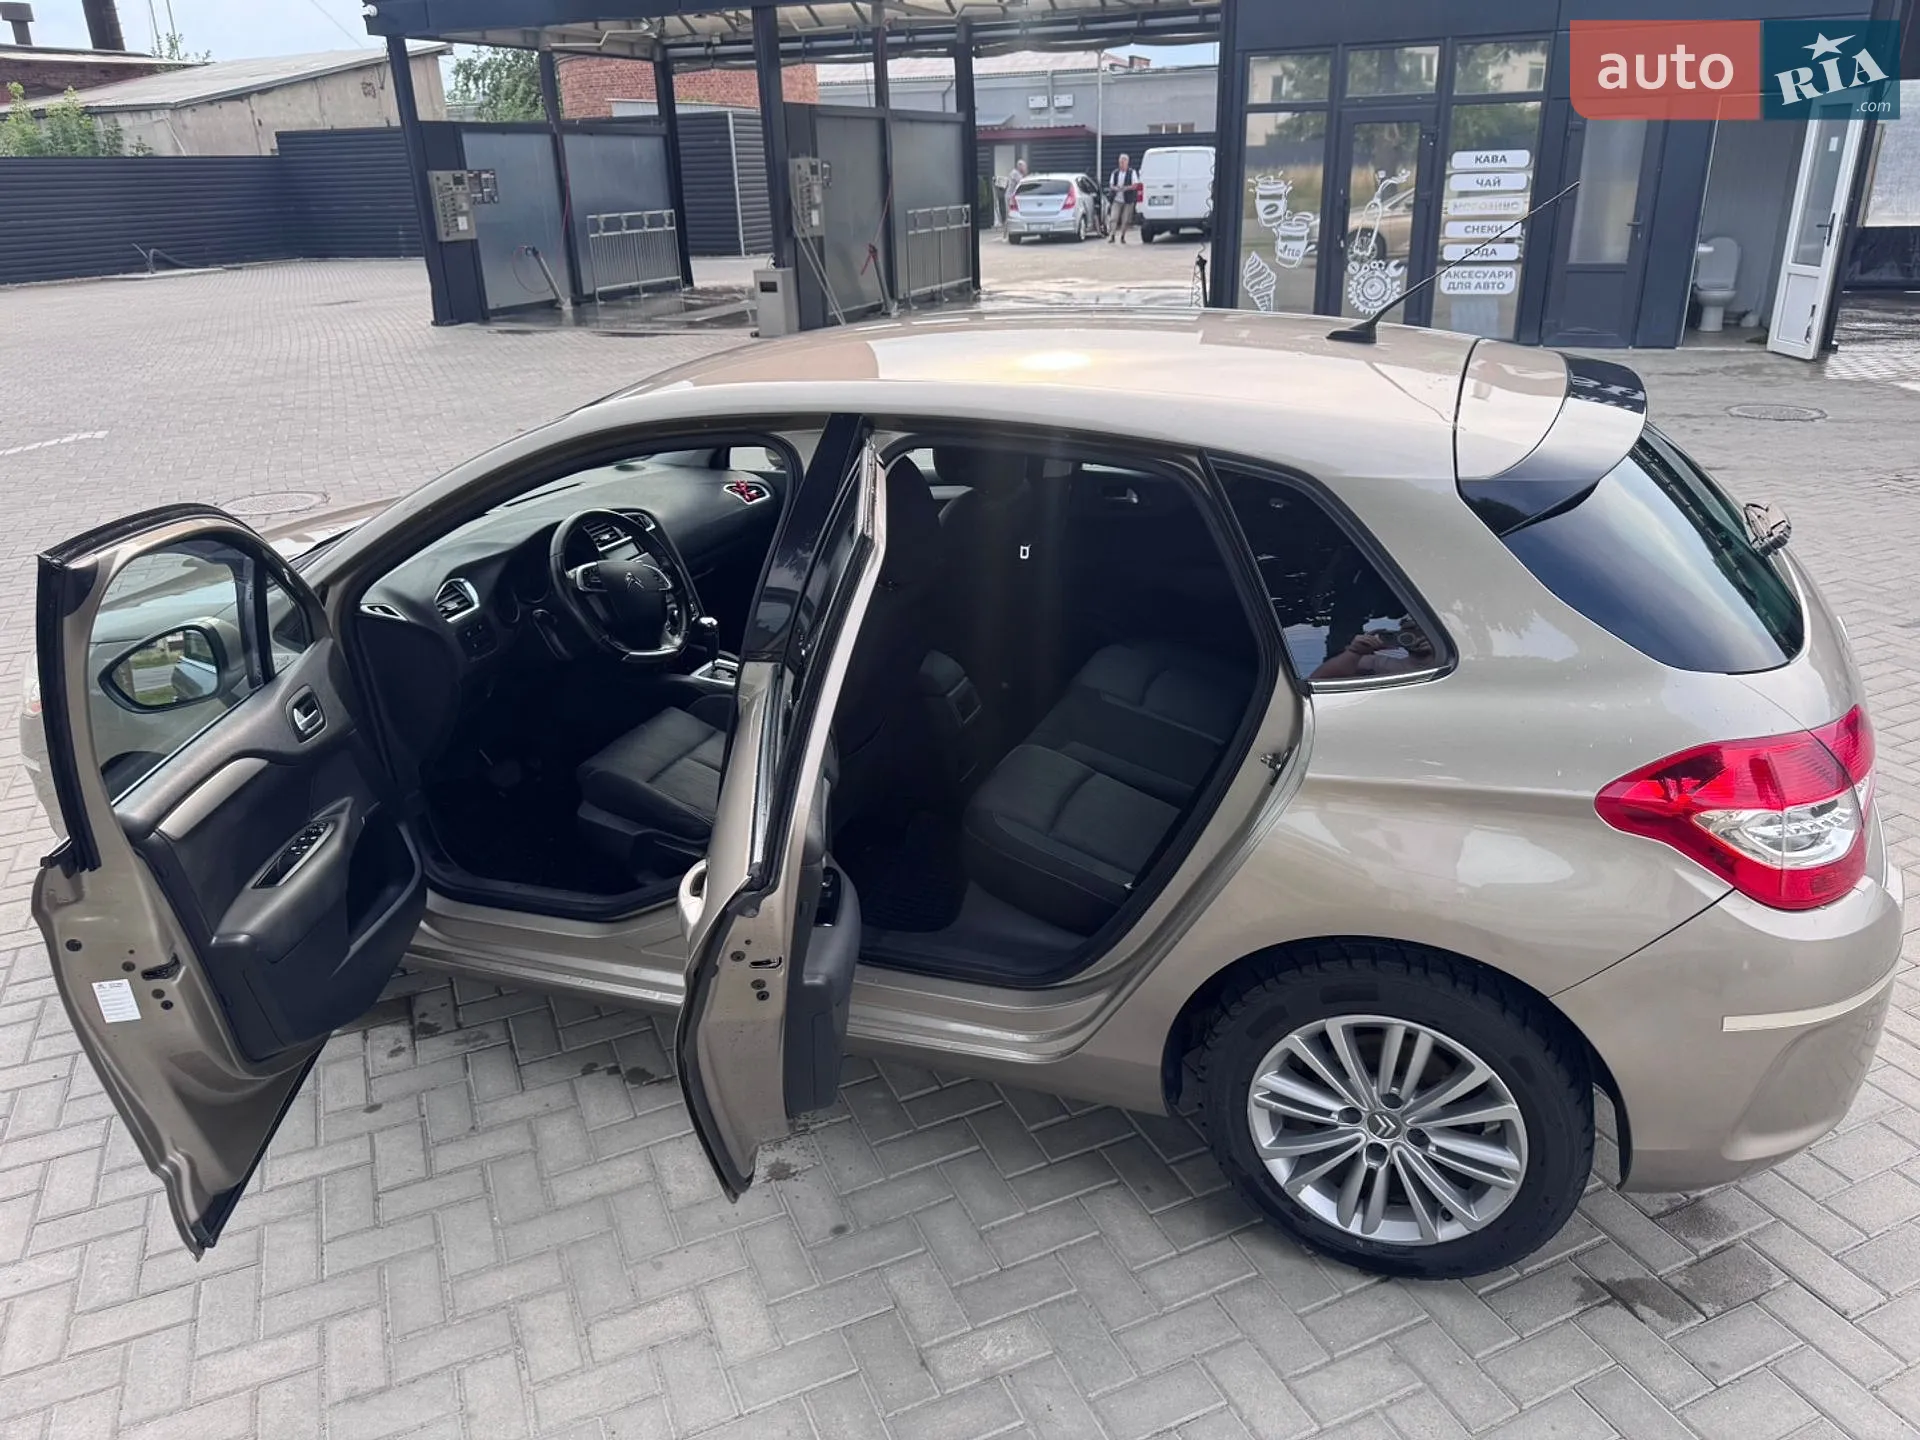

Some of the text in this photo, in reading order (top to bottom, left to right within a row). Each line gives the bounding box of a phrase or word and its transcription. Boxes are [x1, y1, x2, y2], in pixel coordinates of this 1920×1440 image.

[1474, 154, 1508, 164] КАВА
[1475, 176, 1502, 187] ЧАЙ
[1464, 225, 1503, 234] СНЕКИ
[1444, 270, 1514, 279] АКСЕСУАРИ
[1447, 281, 1506, 291] ДЛЯ АВТО
